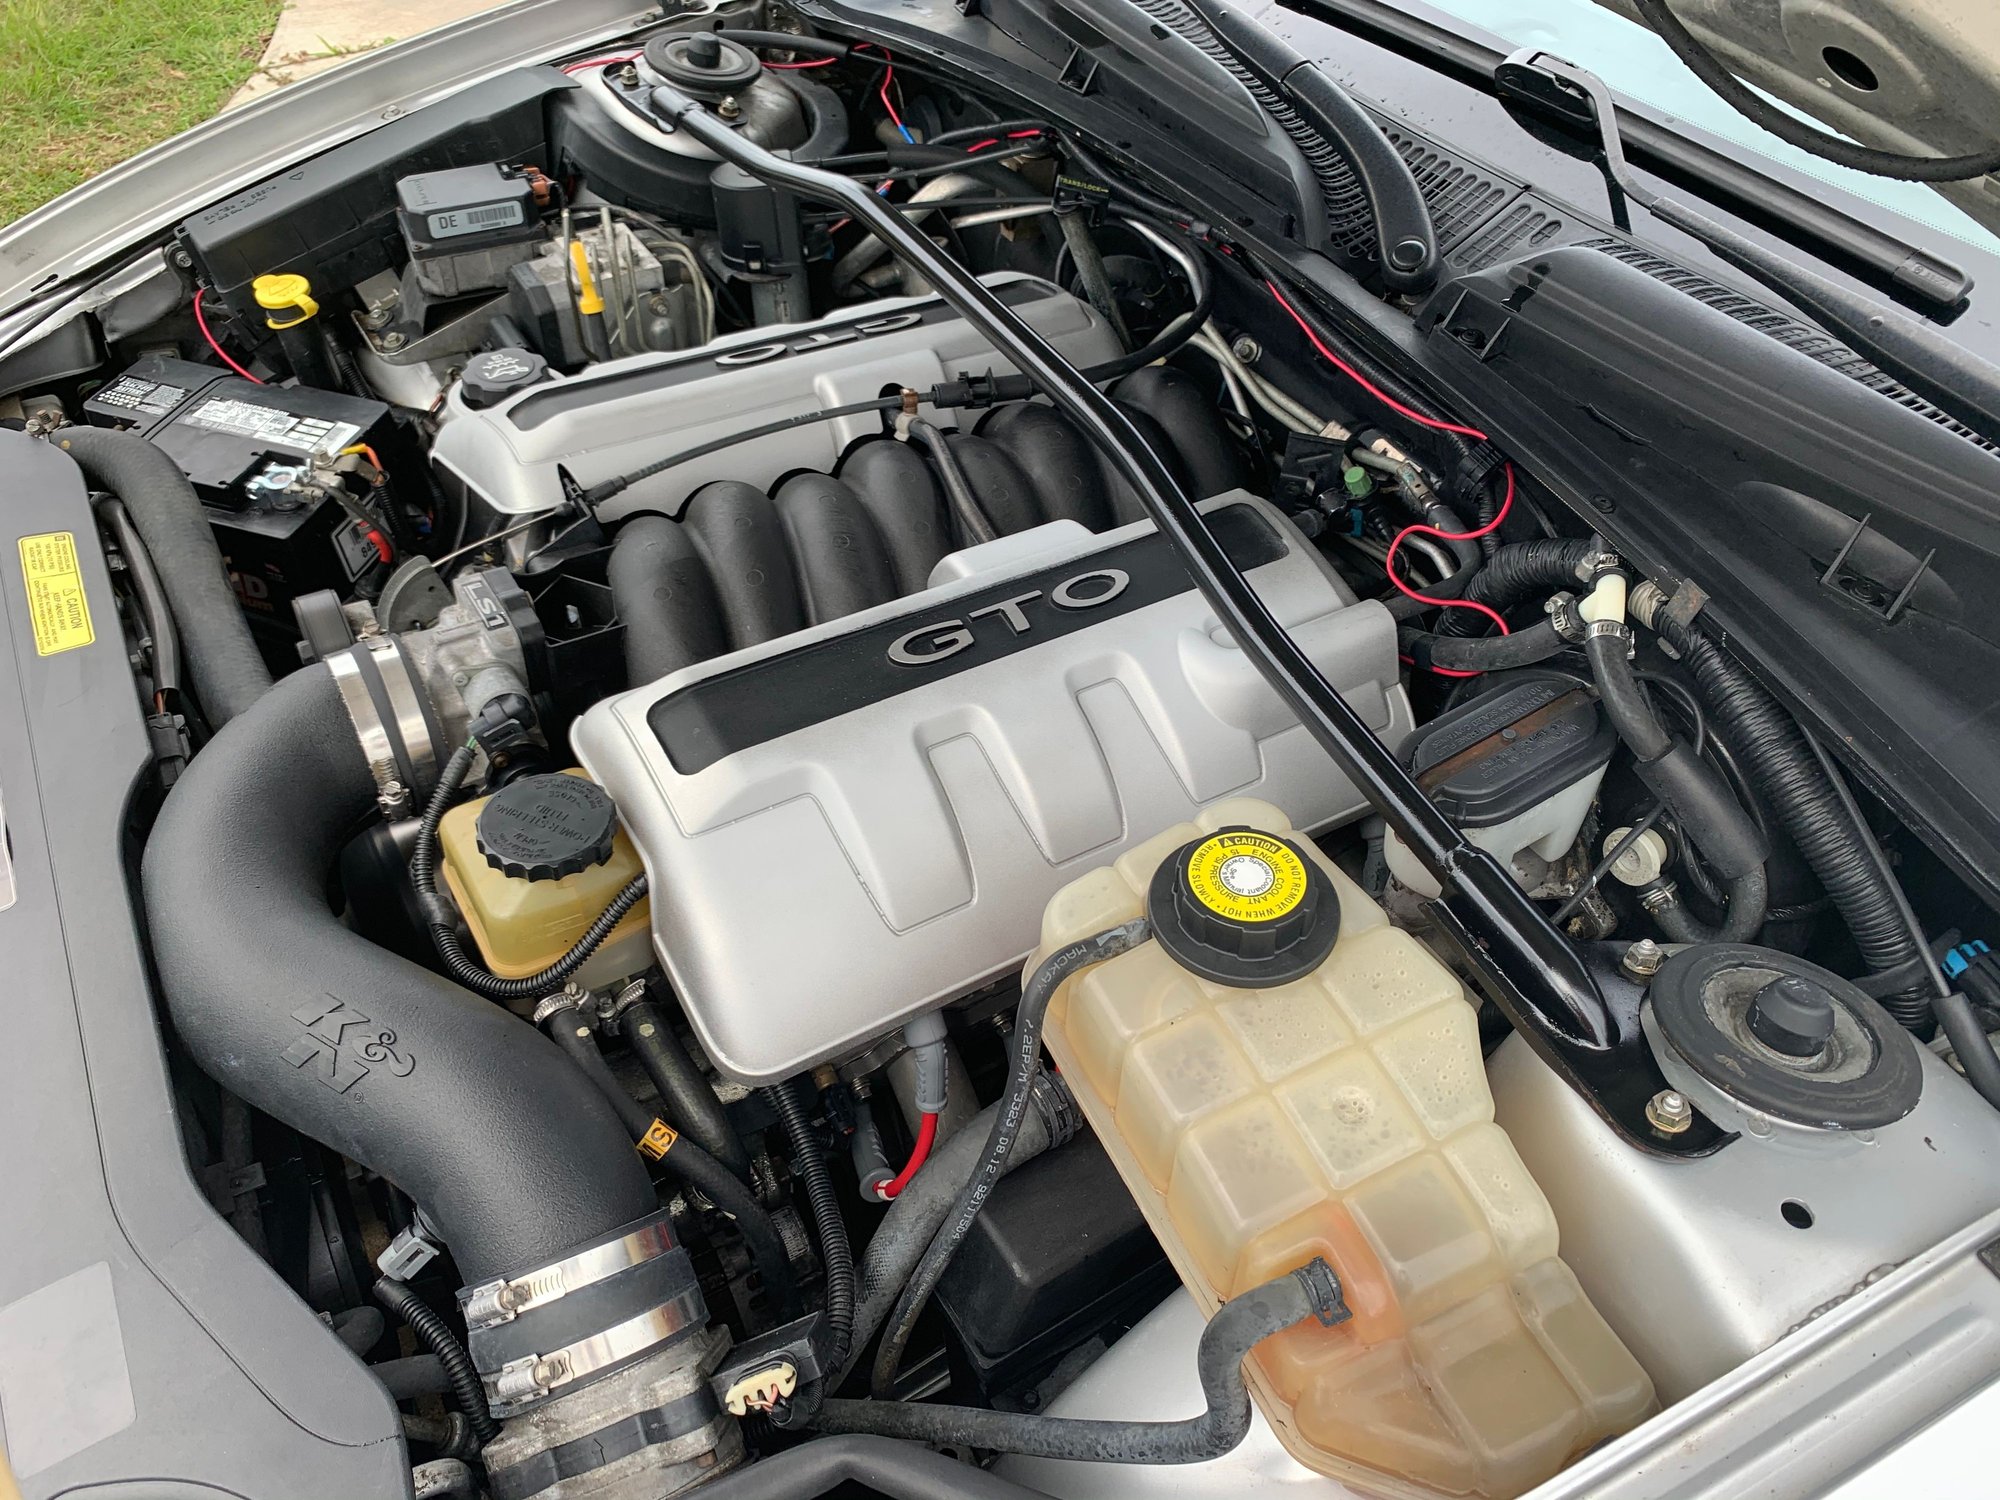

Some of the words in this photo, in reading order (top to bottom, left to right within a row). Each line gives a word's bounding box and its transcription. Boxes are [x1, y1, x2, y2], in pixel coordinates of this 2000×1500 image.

[439, 212, 458, 230] DE
[715, 312, 923, 366] GTO
[66, 597, 83, 629] CAUTION
[467, 581, 504, 628] LS1
[888, 568, 1130, 667] GTO
[1192, 844, 1213, 871] REMOVE
[1234, 837, 1281, 854] CAUTION
[1281, 852, 1294, 864] DO
[1214, 853, 1228, 865] PSI
[1249, 857, 1272, 877] Special
[1251, 849, 1284, 874] ENGINE
[1210, 865, 1240, 903] PRESSURE
[1223, 875, 1245, 894] Manual
[1229, 868, 1237, 879] See
[1248, 876, 1272, 894] Coolant
[1290, 865, 1301, 883] NOT
[1192, 874, 1215, 904] SLOWLY
[1248, 878, 1284, 904] COOLANT
[1276, 884, 1301, 911] REMOVE
[1221, 906, 1242, 917] HOT
[1245, 908, 1276, 918] WHEN
[1035, 944, 1088, 994] MACKAY
[1004, 1091, 1023, 1128] 3323
[985, 1134, 1009, 1175] 08.12
[951, 1183, 988, 1241] 92111504
